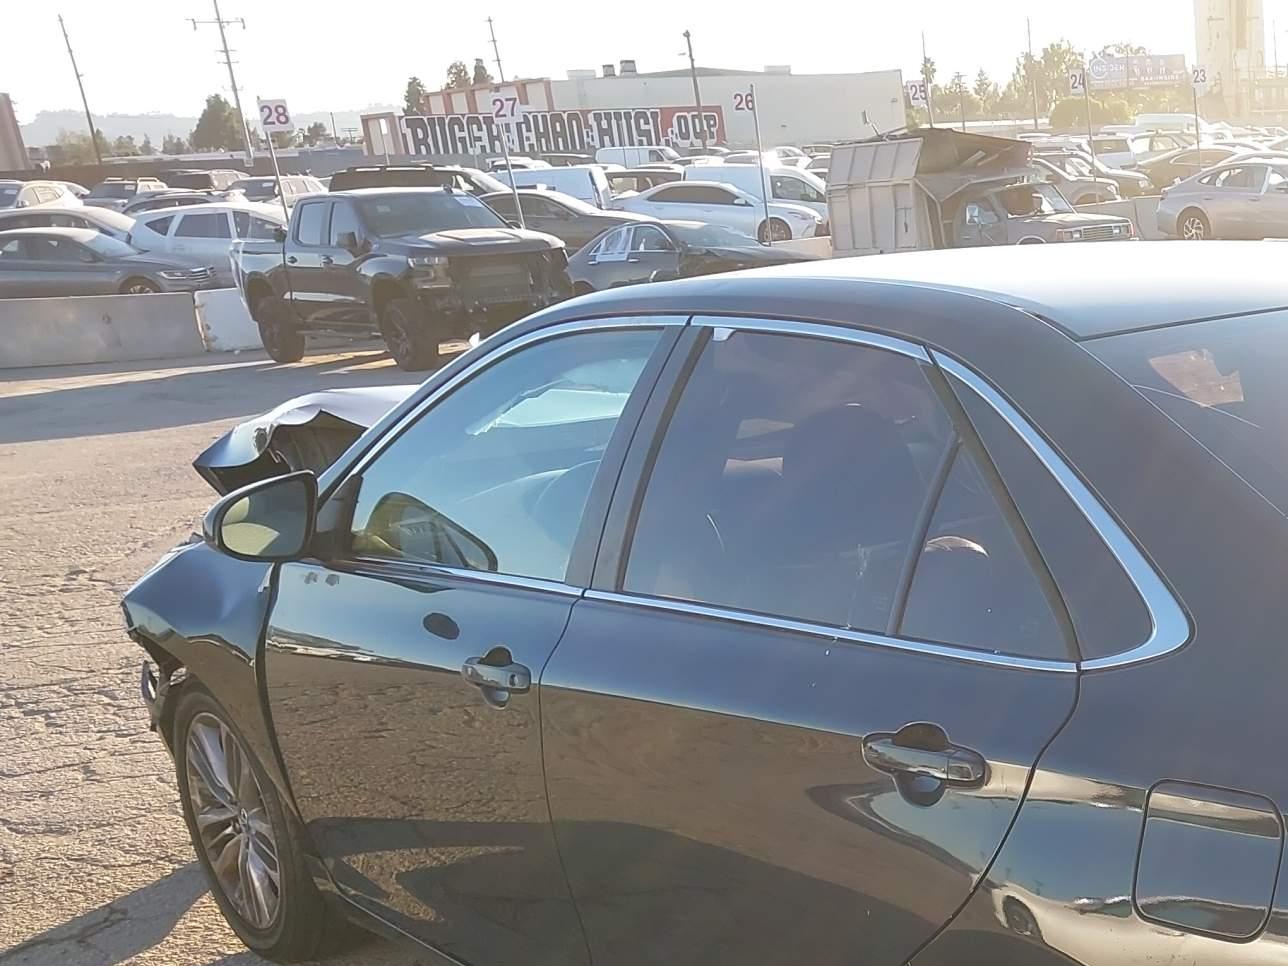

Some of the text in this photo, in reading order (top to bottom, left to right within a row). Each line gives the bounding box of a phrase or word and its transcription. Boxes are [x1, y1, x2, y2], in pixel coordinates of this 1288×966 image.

[1070, 73, 1085, 90] 24
[1193, 69, 1207, 83] 23
[910, 83, 928, 100] 25
[492, 97, 517, 118] 27
[733, 93, 754, 111] 26
[260, 104, 290, 126] 28
